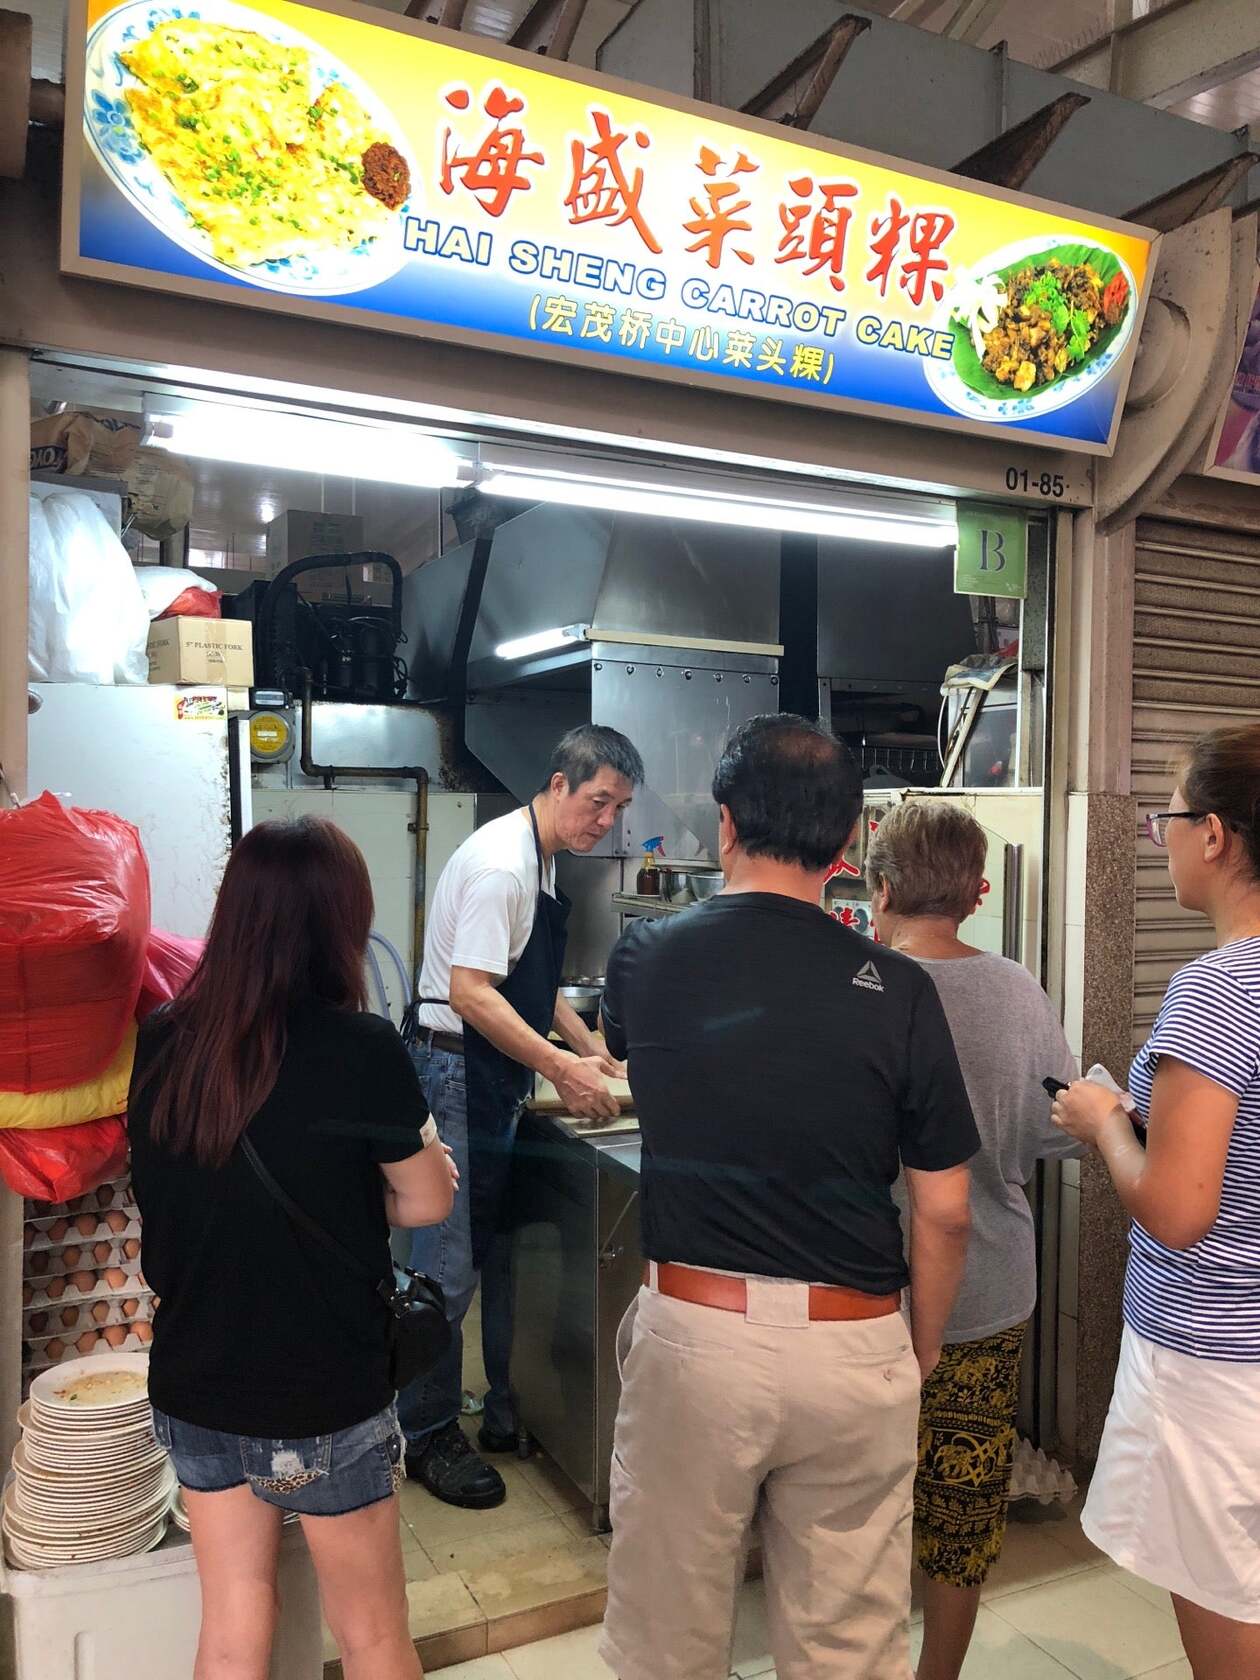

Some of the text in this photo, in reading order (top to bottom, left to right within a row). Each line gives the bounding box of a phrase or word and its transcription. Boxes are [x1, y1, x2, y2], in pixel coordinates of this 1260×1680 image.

[440, 87, 955, 305] 海盛菜頭粿
[403, 216, 956, 360] HAI SHENG CARROT CAKE
[528, 294, 834, 384] (宏茂桥中心菜头粿)
[1006, 467, 1064, 497] 01-85
[978, 529, 1007, 572] B
[194, 642, 223, 650] PLASTIC
[852, 977, 885, 993] Reebok
